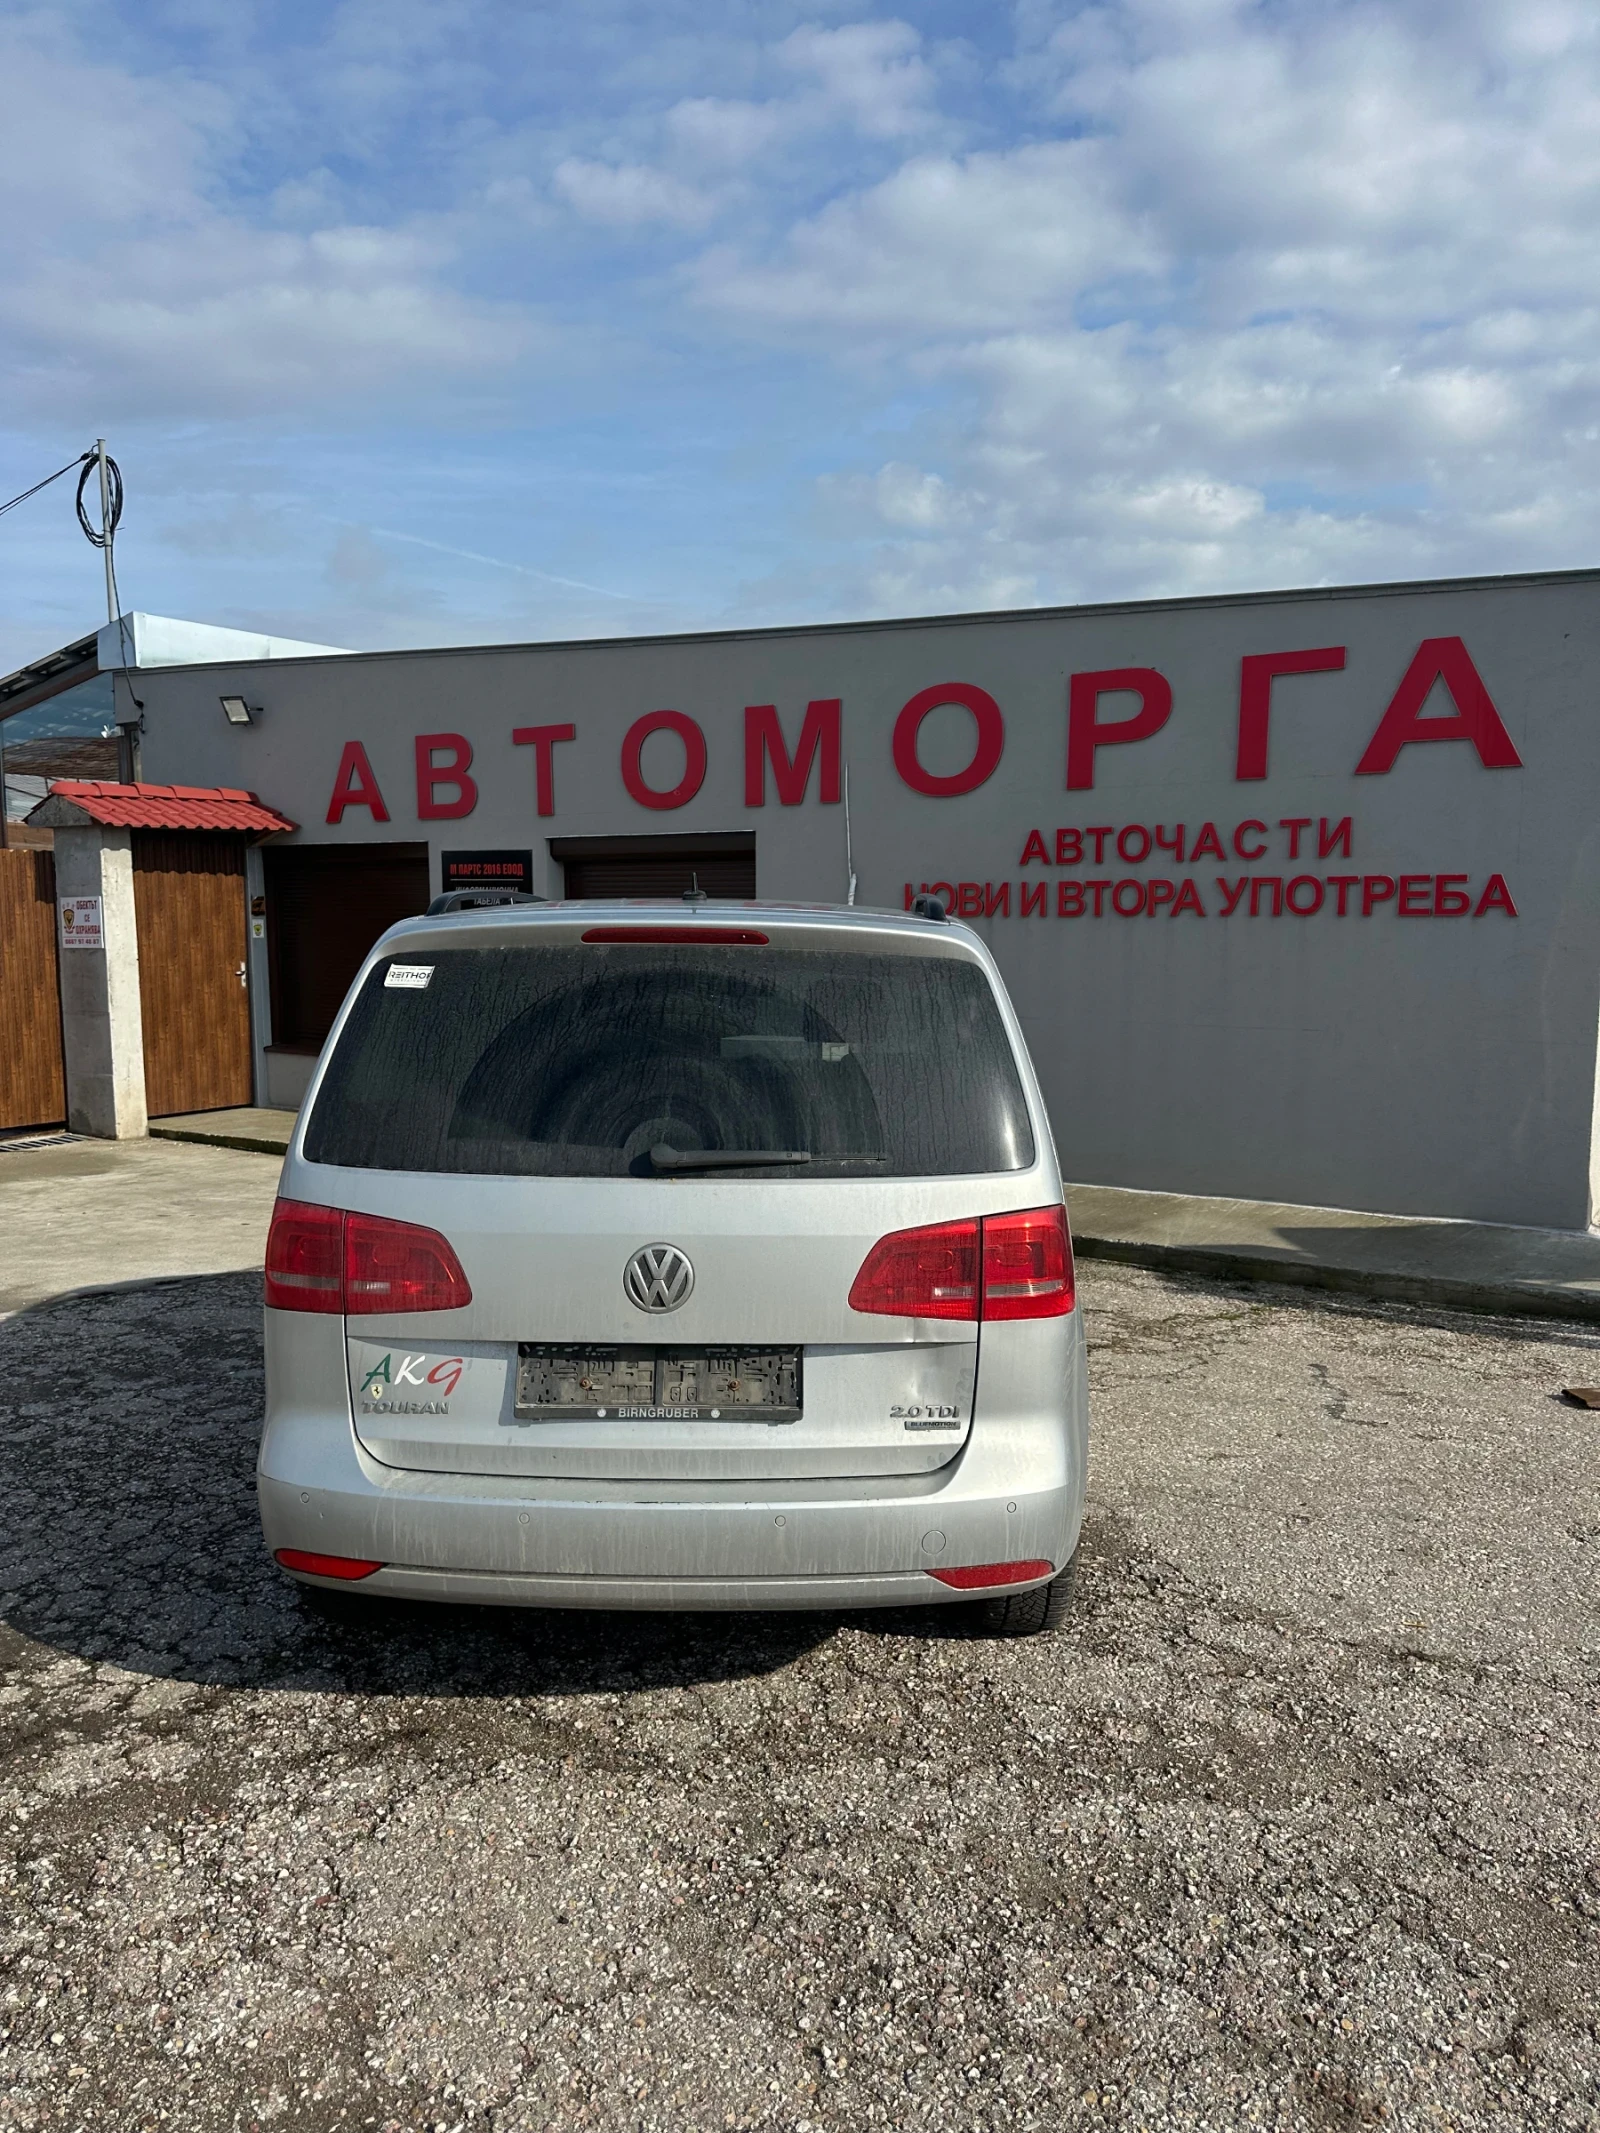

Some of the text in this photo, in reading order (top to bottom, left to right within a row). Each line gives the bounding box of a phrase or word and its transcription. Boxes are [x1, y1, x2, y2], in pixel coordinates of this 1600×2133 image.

[326, 637, 1522, 824] АВТОМОРГА
[1020, 816, 1353, 866] АВТОЧАСТИ
[1020, 881, 1047, 918] И
[1057, 878, 1205, 917] ВТОРА
[1218, 874, 1518, 917] УПОТРЕБА
[361, 1400, 450, 1415] TOURAN
[618, 1407, 699, 1419] BIRNGRUBER
[925, 1405, 960, 1418] TDI
